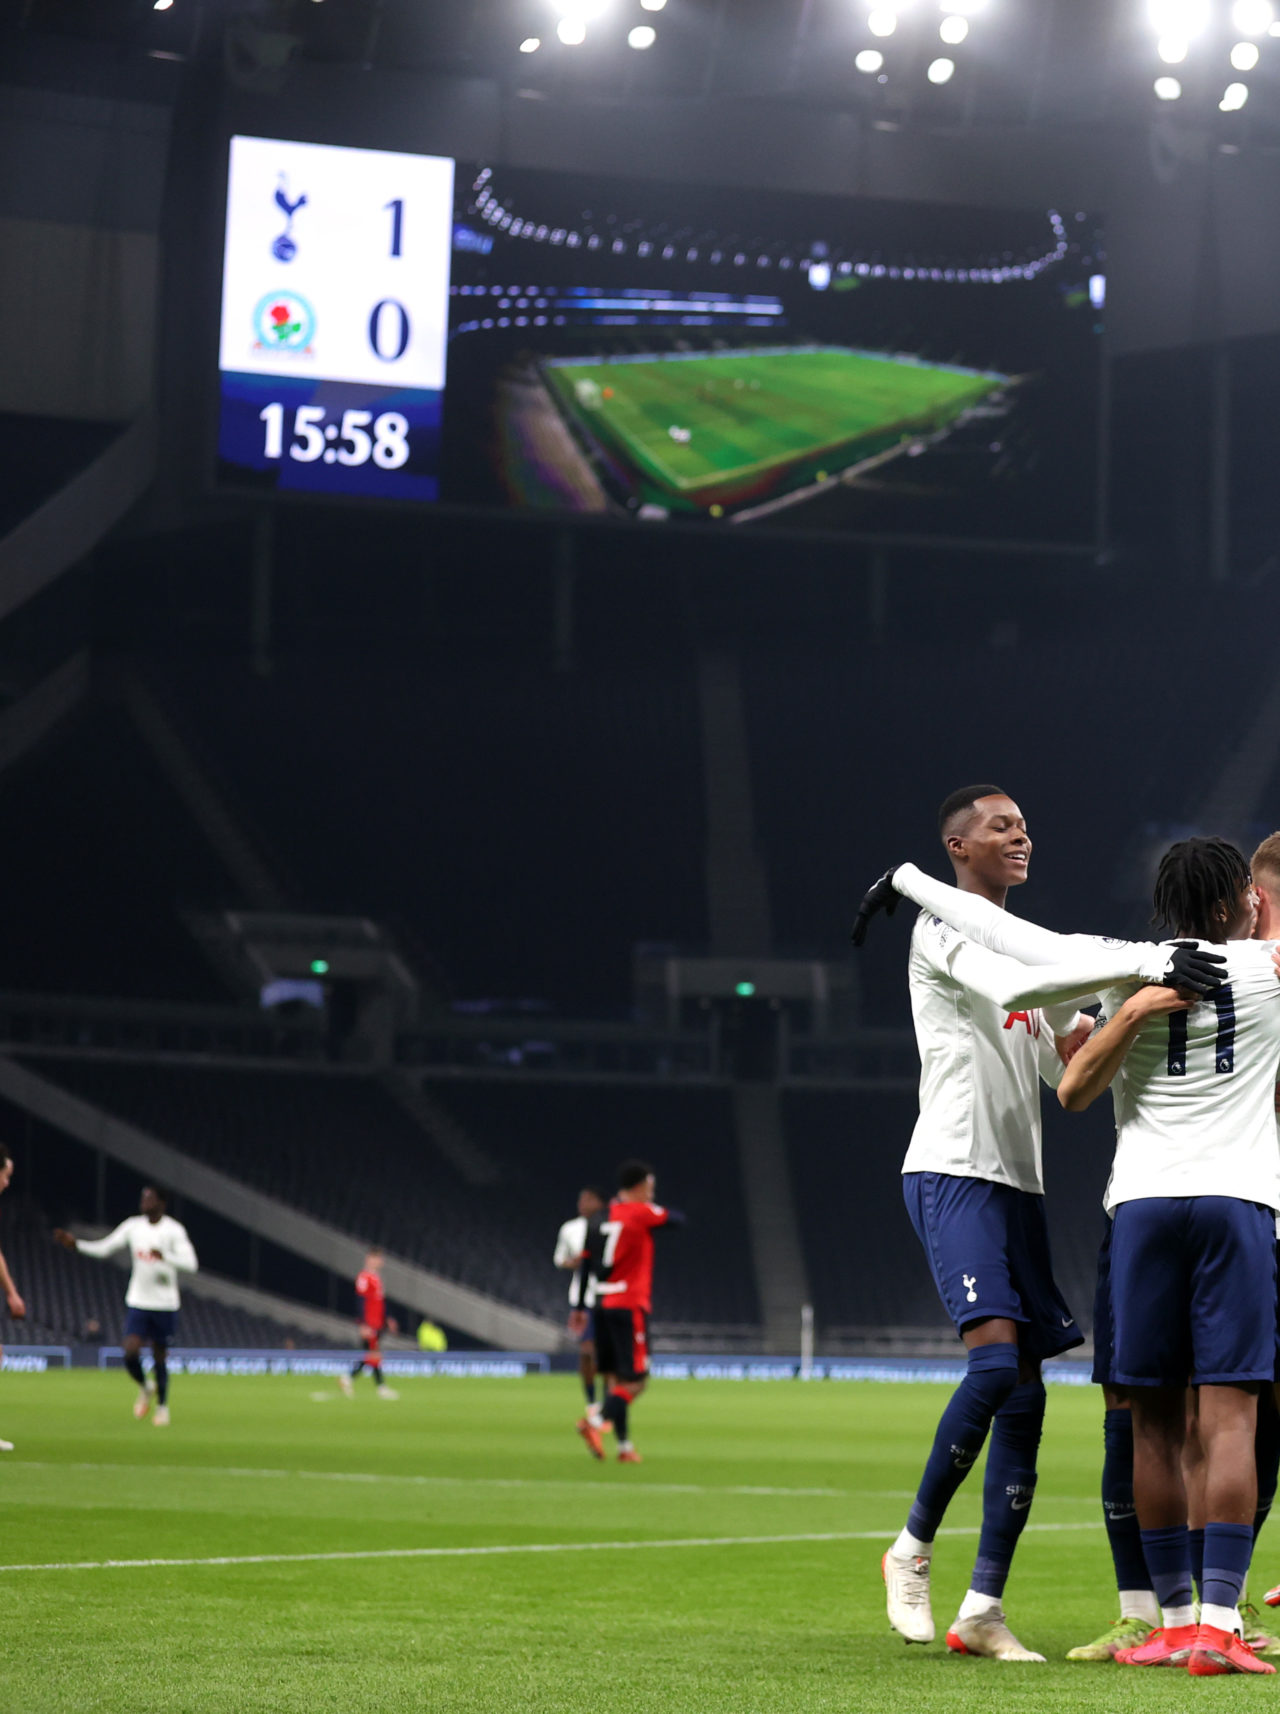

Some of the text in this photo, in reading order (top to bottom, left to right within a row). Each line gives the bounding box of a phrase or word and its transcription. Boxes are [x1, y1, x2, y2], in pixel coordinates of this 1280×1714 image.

[383, 198, 403, 258] 1
[368, 298, 410, 362] 0
[259, 402, 410, 470] 15:58
[1167, 985, 1236, 1076] 11
[599, 1220, 624, 1268] 7
